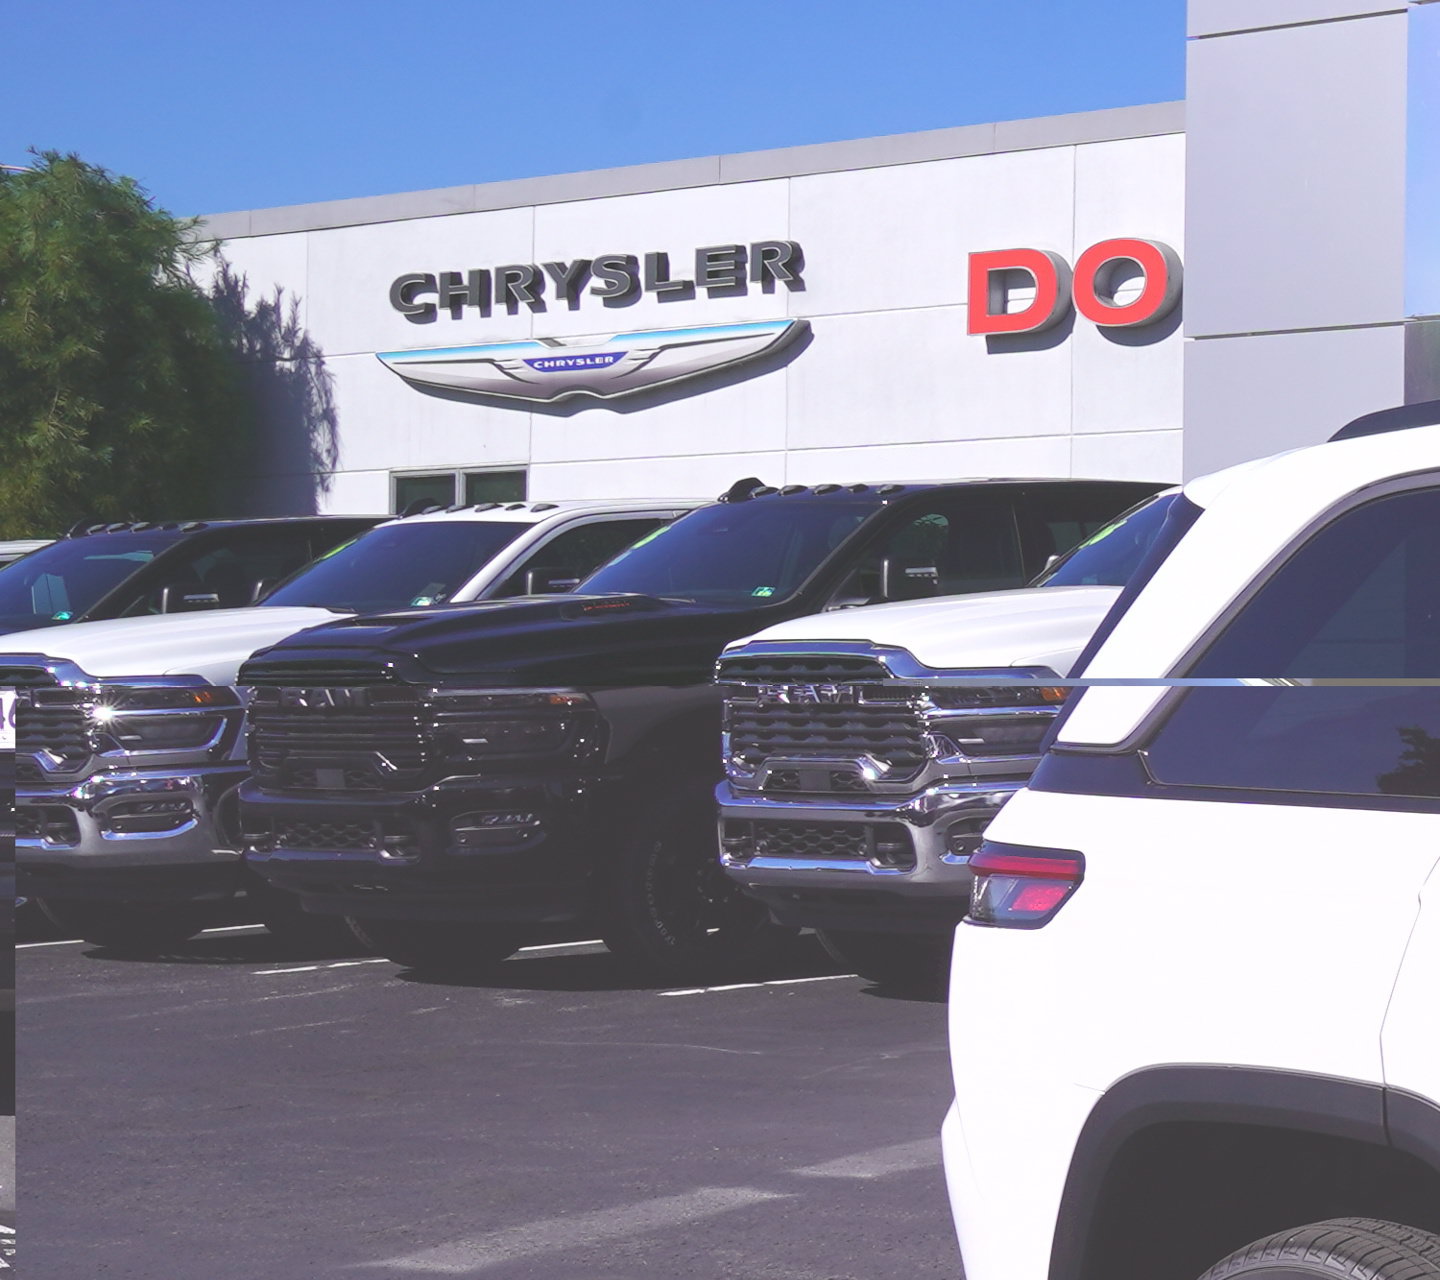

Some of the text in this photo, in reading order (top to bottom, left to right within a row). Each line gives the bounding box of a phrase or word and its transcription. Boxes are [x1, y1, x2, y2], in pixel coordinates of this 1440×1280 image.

[390, 240, 804, 321] CHRYSLER
[967, 237, 1176, 337] DO
[533, 355, 615, 370] CHRYSLER
